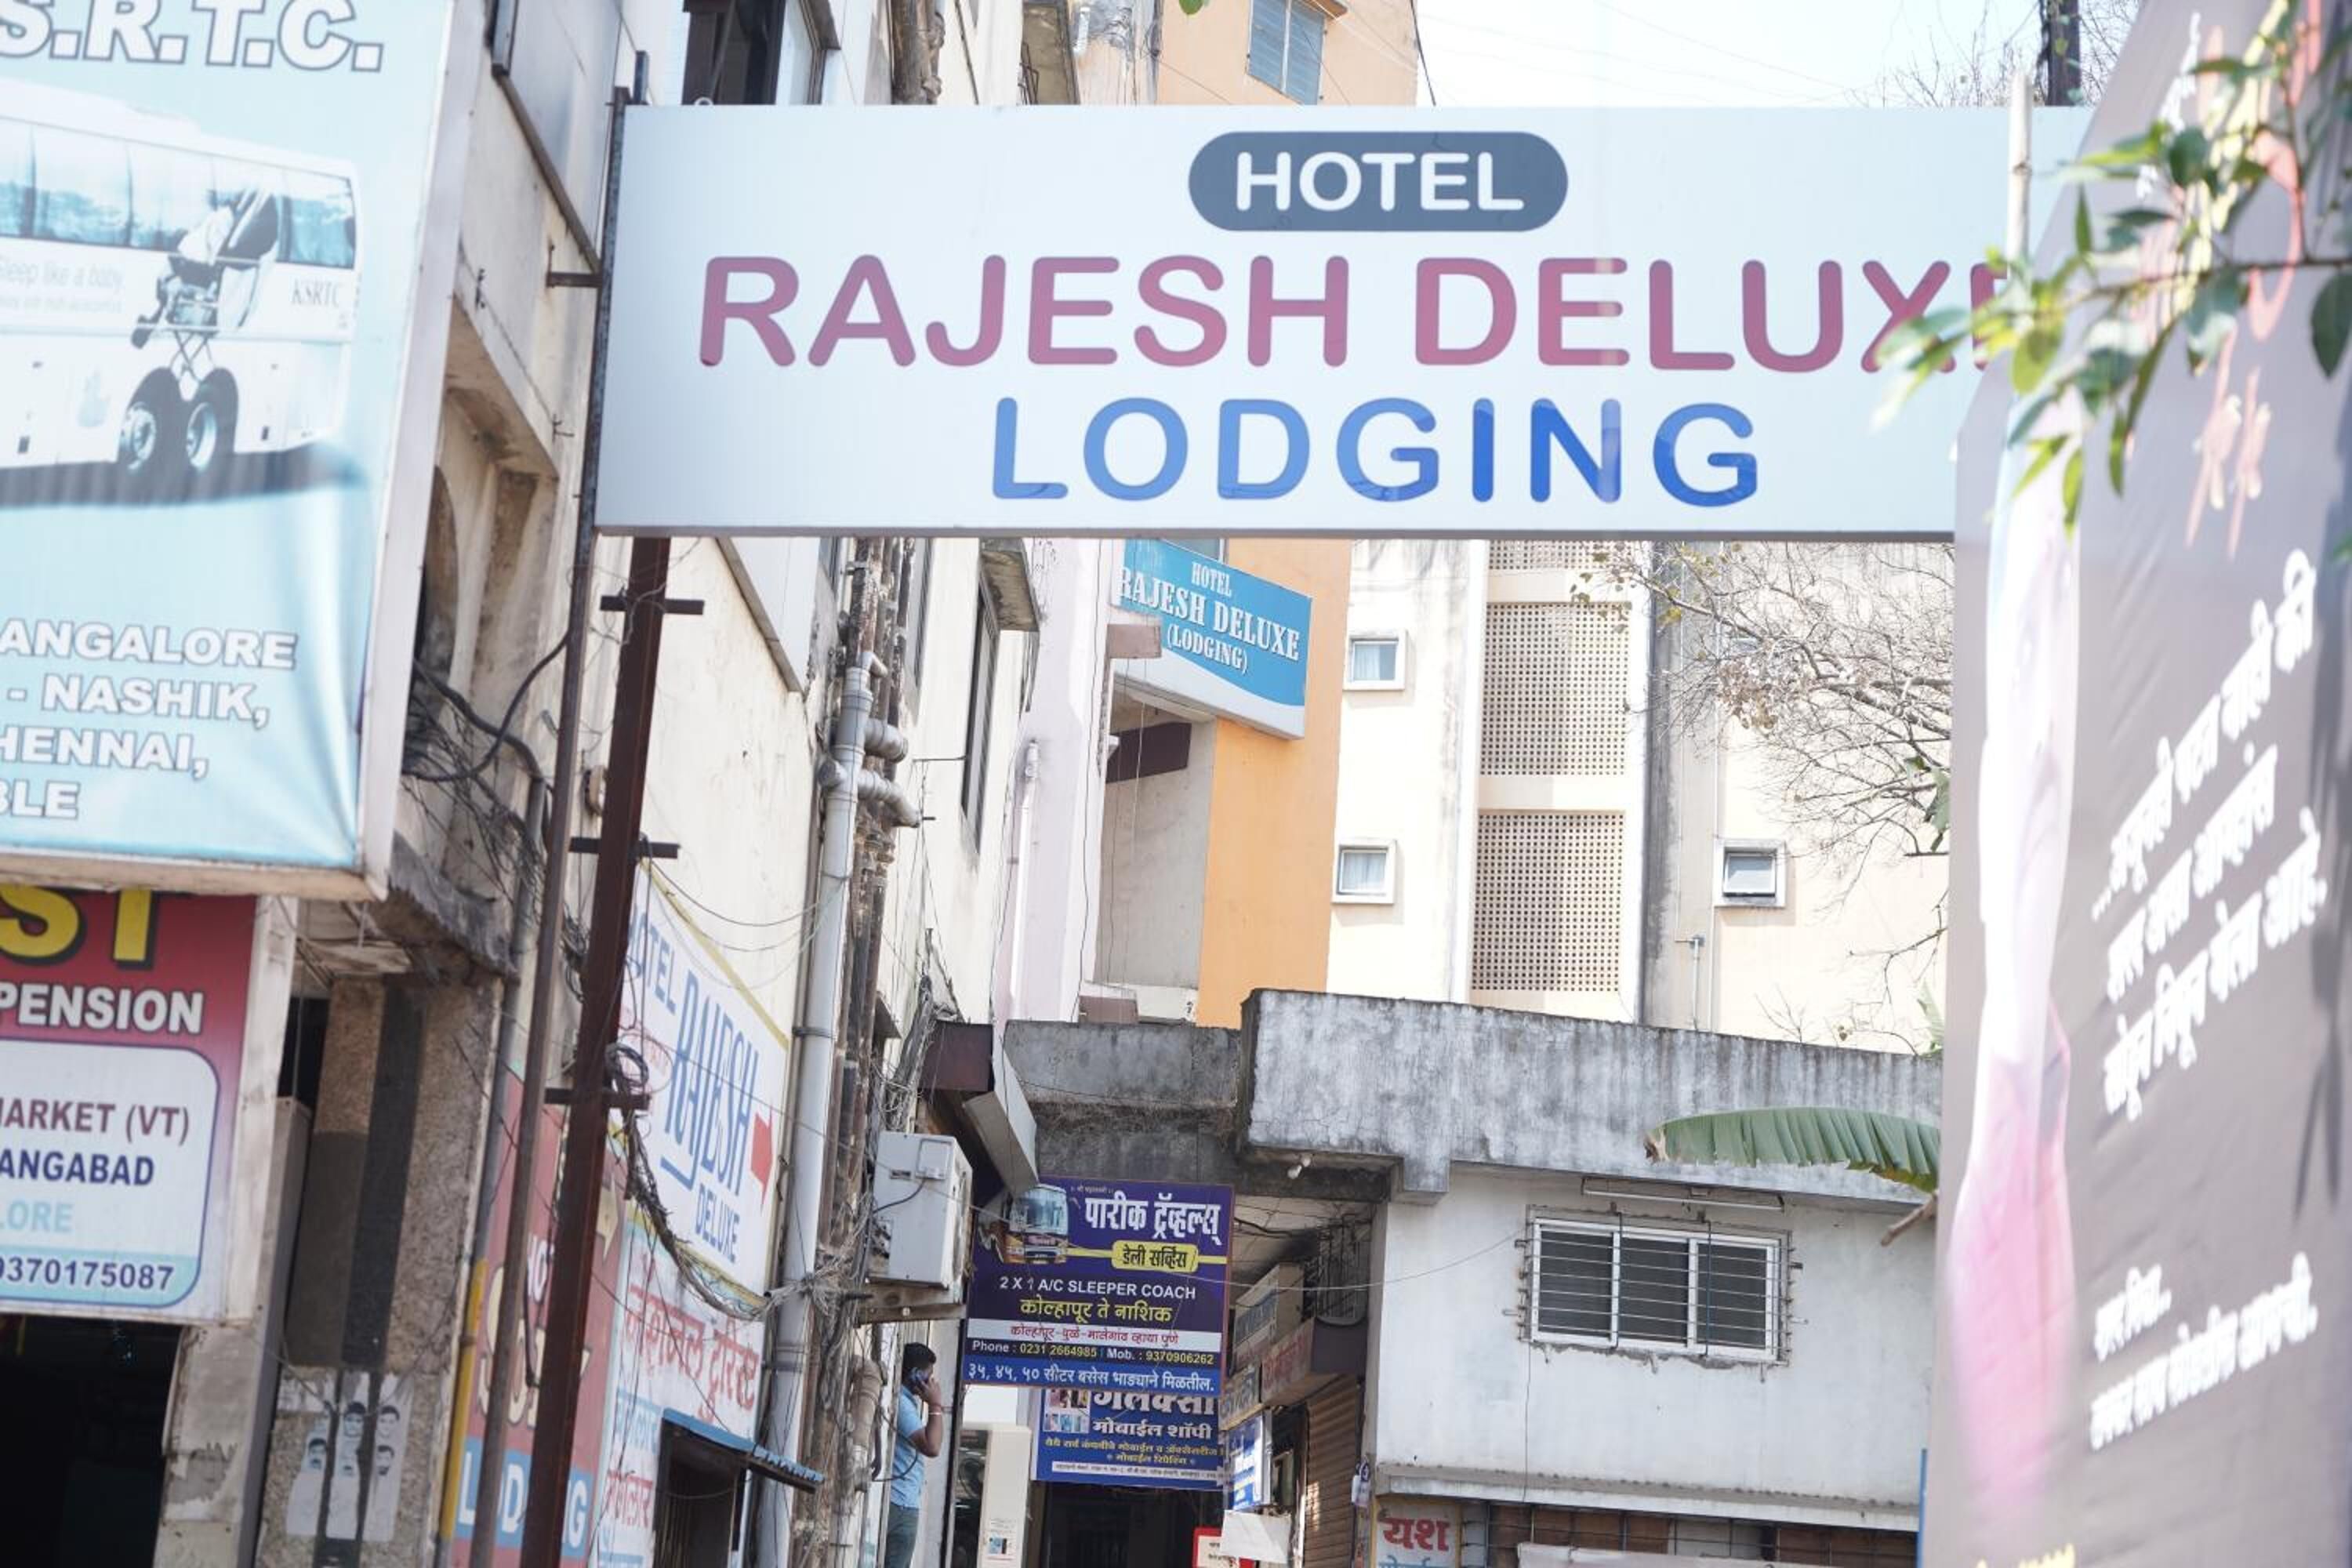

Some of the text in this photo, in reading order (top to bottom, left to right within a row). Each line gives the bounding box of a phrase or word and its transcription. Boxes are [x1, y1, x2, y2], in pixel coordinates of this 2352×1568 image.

[1236, 151, 1524, 212] HOTEL
[699, 255, 1349, 368] RAJESH
[993, 397, 1759, 507] LODGING
[1192, 561, 1232, 597] HOTEL
[1118, 566, 1300, 662] RAJESH DELUXE
[0, 619, 298, 670] ANGALORE
[1167, 623, 1248, 674] (LODGING)
[42, 673, 270, 731] NASHIK,
[0, 982, 204, 1035] PENSION
[660, 968, 759, 1196] RAJESH
[0, 1098, 191, 1146] ARKET (VT)
[0, 1149, 154, 1186] ANGABAD
[0, 1200, 74, 1233] ORE
[694, 1186, 741, 1265] DELUXE
[1084, 1190, 1149, 1230] पारीक
[0, 1257, 174, 1290] 370175087
[1123, 1244, 1145, 1266] डेली
[1000, 1276, 1009, 1289] 2
[1038, 1279, 1063, 1291] A/C
[1068, 1280, 1137, 1296] SLEEPER
[1142, 1283, 1196, 1299] COACH
[1020, 1294, 1173, 1323] कोल्हापूर ते नाशिक
[972, 1341, 1009, 1353] Phone
[1020, 1344, 1045, 1355] 0231
[1145, 1351, 1214, 1365] 9370906262
[1093, 1417, 1212, 1439] मोबाईल शॉपी
[1377, 1518, 1450, 1552] यश
